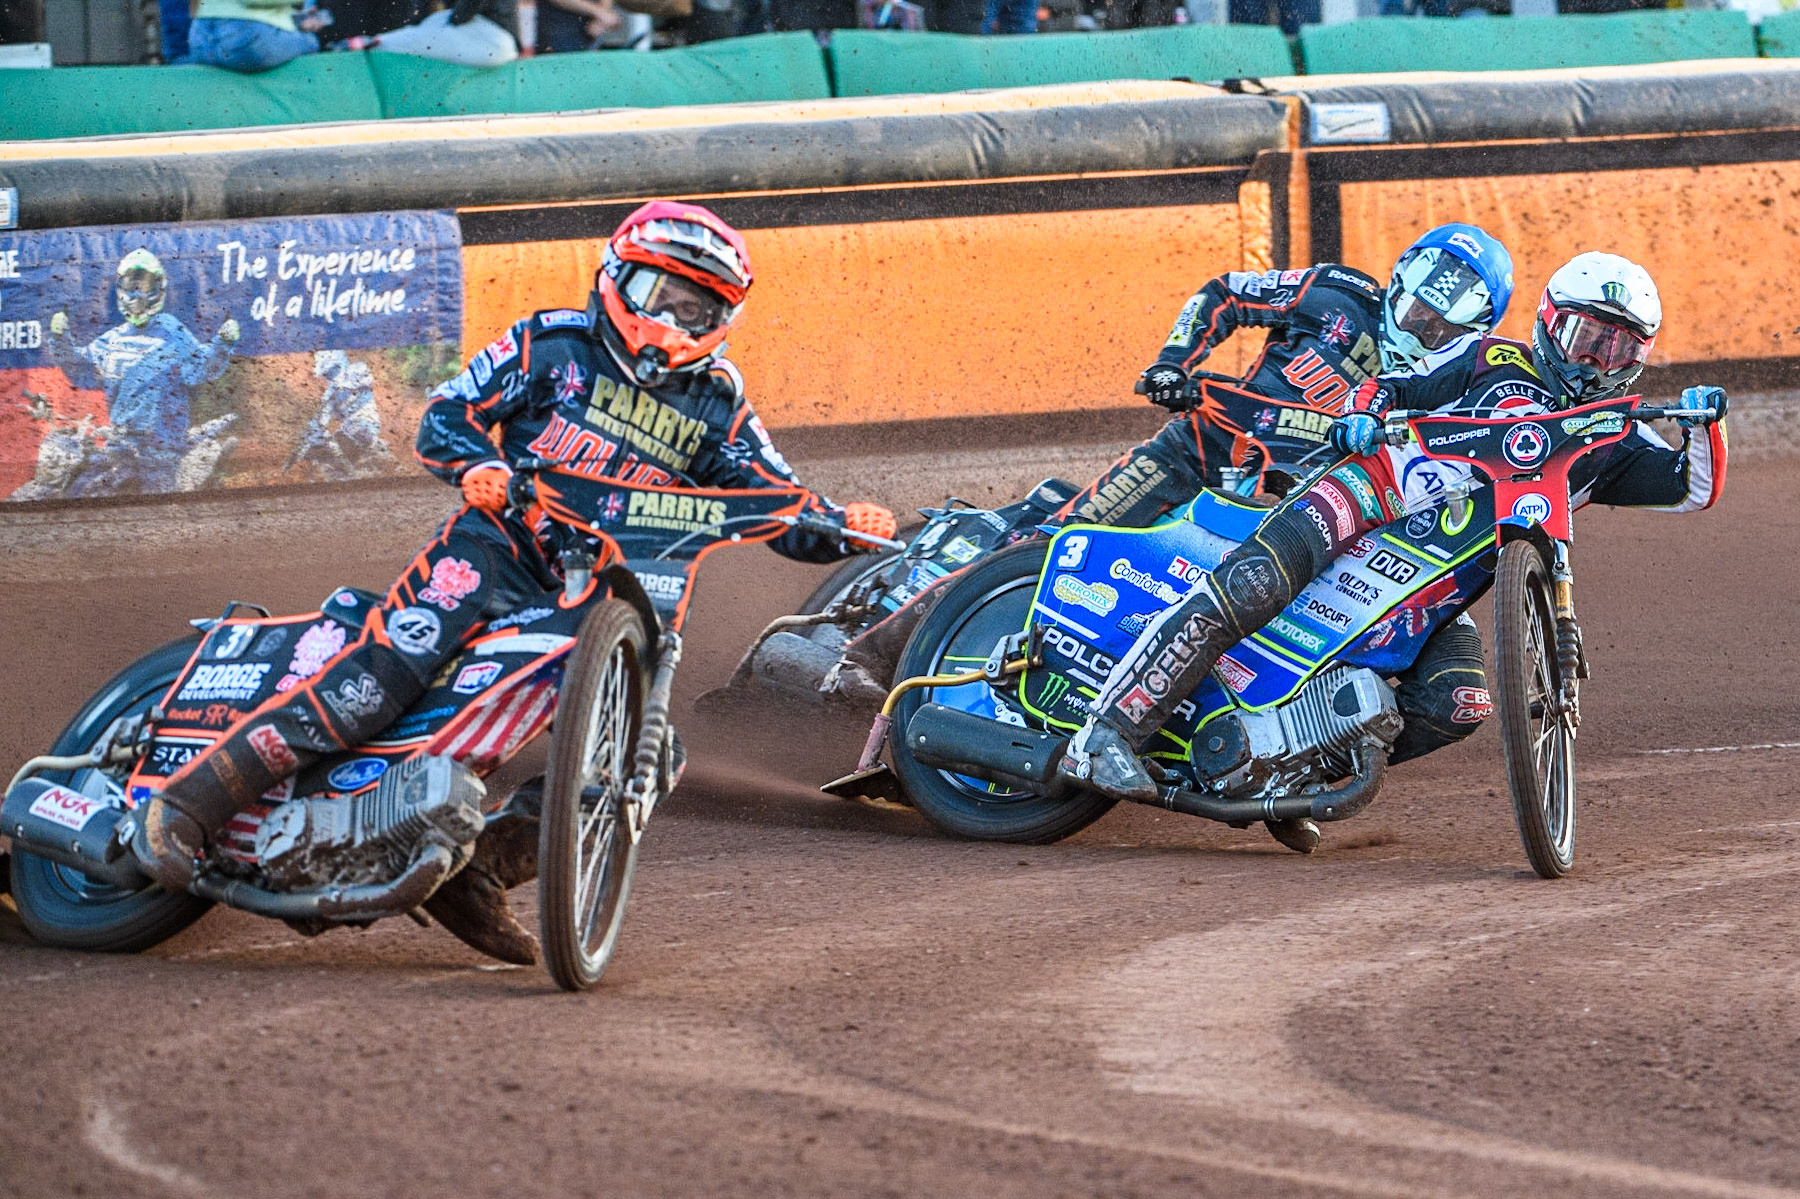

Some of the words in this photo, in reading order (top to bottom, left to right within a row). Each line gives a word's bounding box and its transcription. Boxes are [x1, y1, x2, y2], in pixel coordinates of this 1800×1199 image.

[217, 241, 268, 283] The
[278, 239, 416, 290] Experience
[250, 283, 280, 327] of
[285, 291, 302, 318] a
[1422, 286, 1449, 309] BELL
[1495, 384, 1535, 399] BELLE
[1541, 395, 1558, 411] VU
[590, 373, 708, 456] PARRYS
[1278, 408, 1335, 436] PARR
[1428, 426, 1491, 448] POLCOPPER
[1534, 427, 1547, 441] ACES
[1079, 454, 1158, 521] PARRYS
[1096, 470, 1168, 525] NTERNATIONAL
[629, 490, 728, 526] PARRYS
[1519, 503, 1544, 516] ATPI
[1304, 504, 1333, 551] DOCUFY
[1057, 535, 1089, 568] 3
[1369, 553, 1418, 582] DVR
[1060, 578, 1110, 608] AGROMIX
[1335, 583, 1373, 607] CONCRETING
[1339, 572, 1383, 600] OLDY'S
[1307, 599, 1353, 627] DOCUFY
[216, 624, 250, 659] 3
[1267, 615, 1324, 652] MOTOREX
[1042, 627, 1115, 677] POLC
[184, 662, 272, 690] BORGE
[177, 688, 256, 701] DEVELOPMENT
[1456, 706, 1493, 720] BINS
[43, 789, 92, 816] NGK
